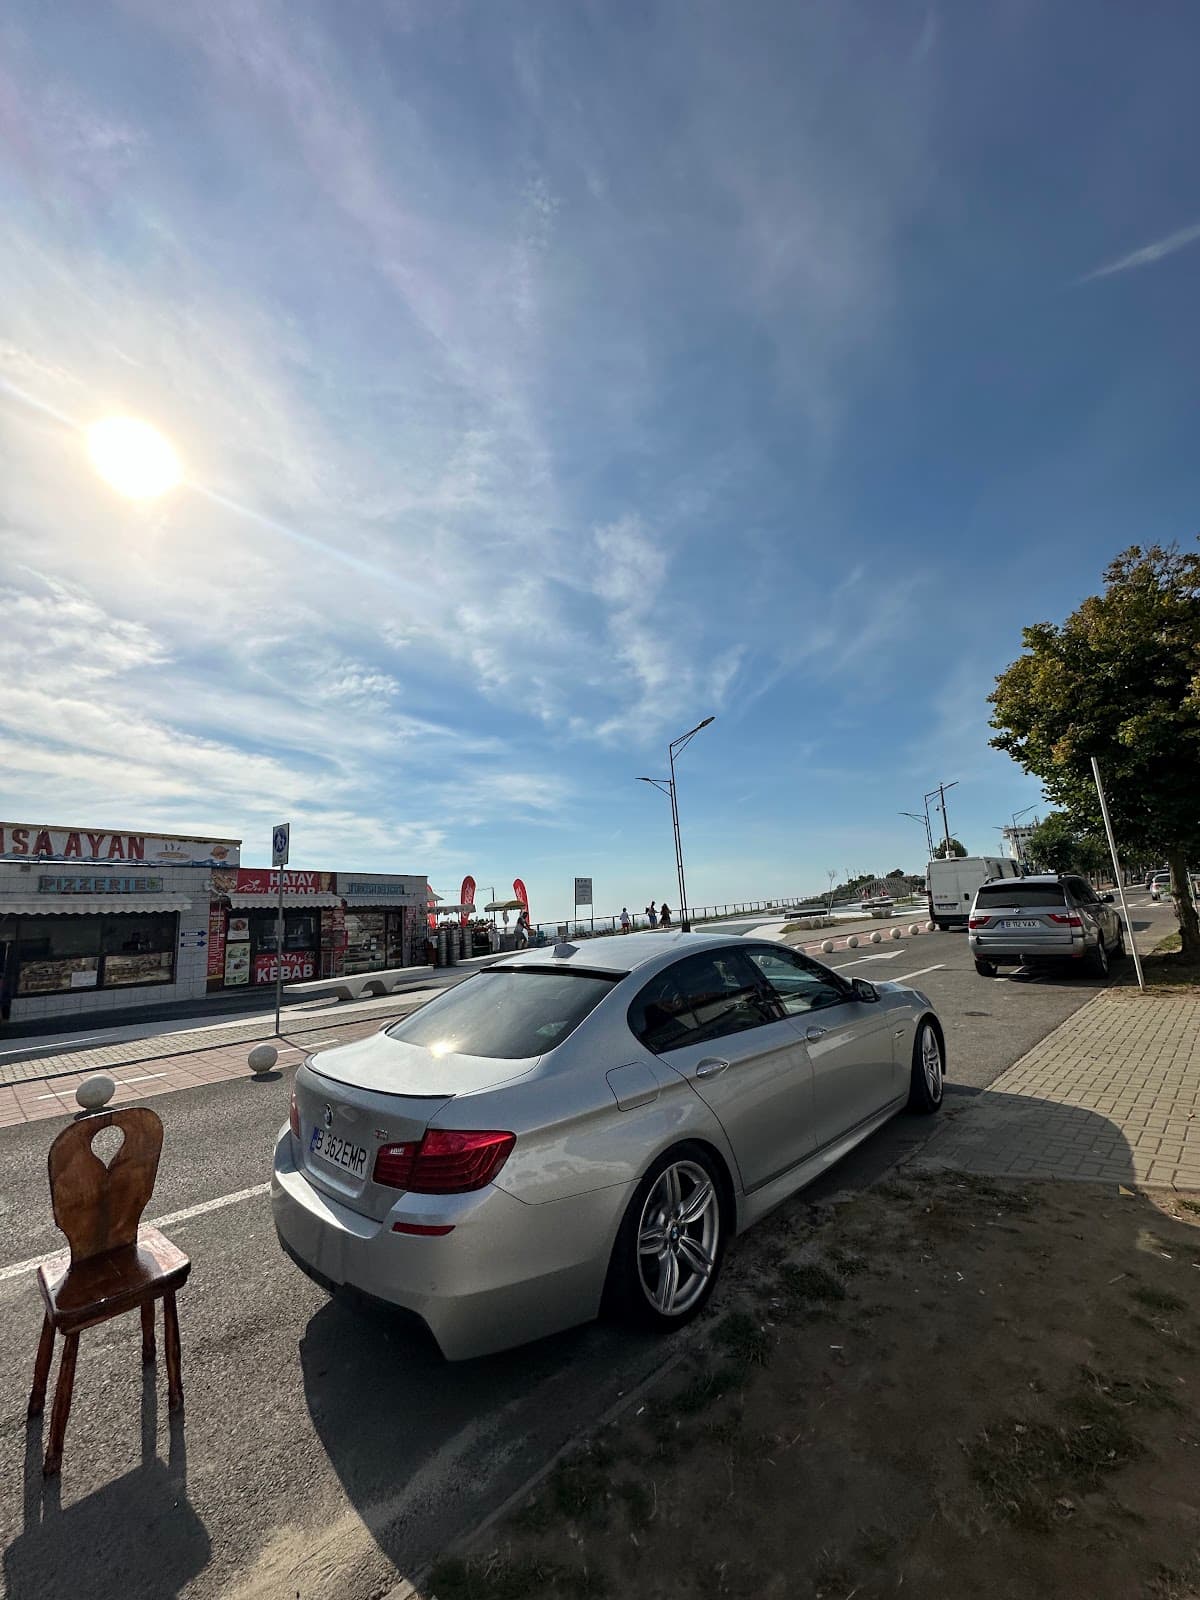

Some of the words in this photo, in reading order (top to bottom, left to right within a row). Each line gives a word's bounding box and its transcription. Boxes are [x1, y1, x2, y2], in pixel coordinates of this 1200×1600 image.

[64, 832, 145, 860] AYAN
[43, 878, 146, 891] PIZZERIE
[269, 872, 315, 886] HATAY
[257, 963, 314, 983] KEBAB
